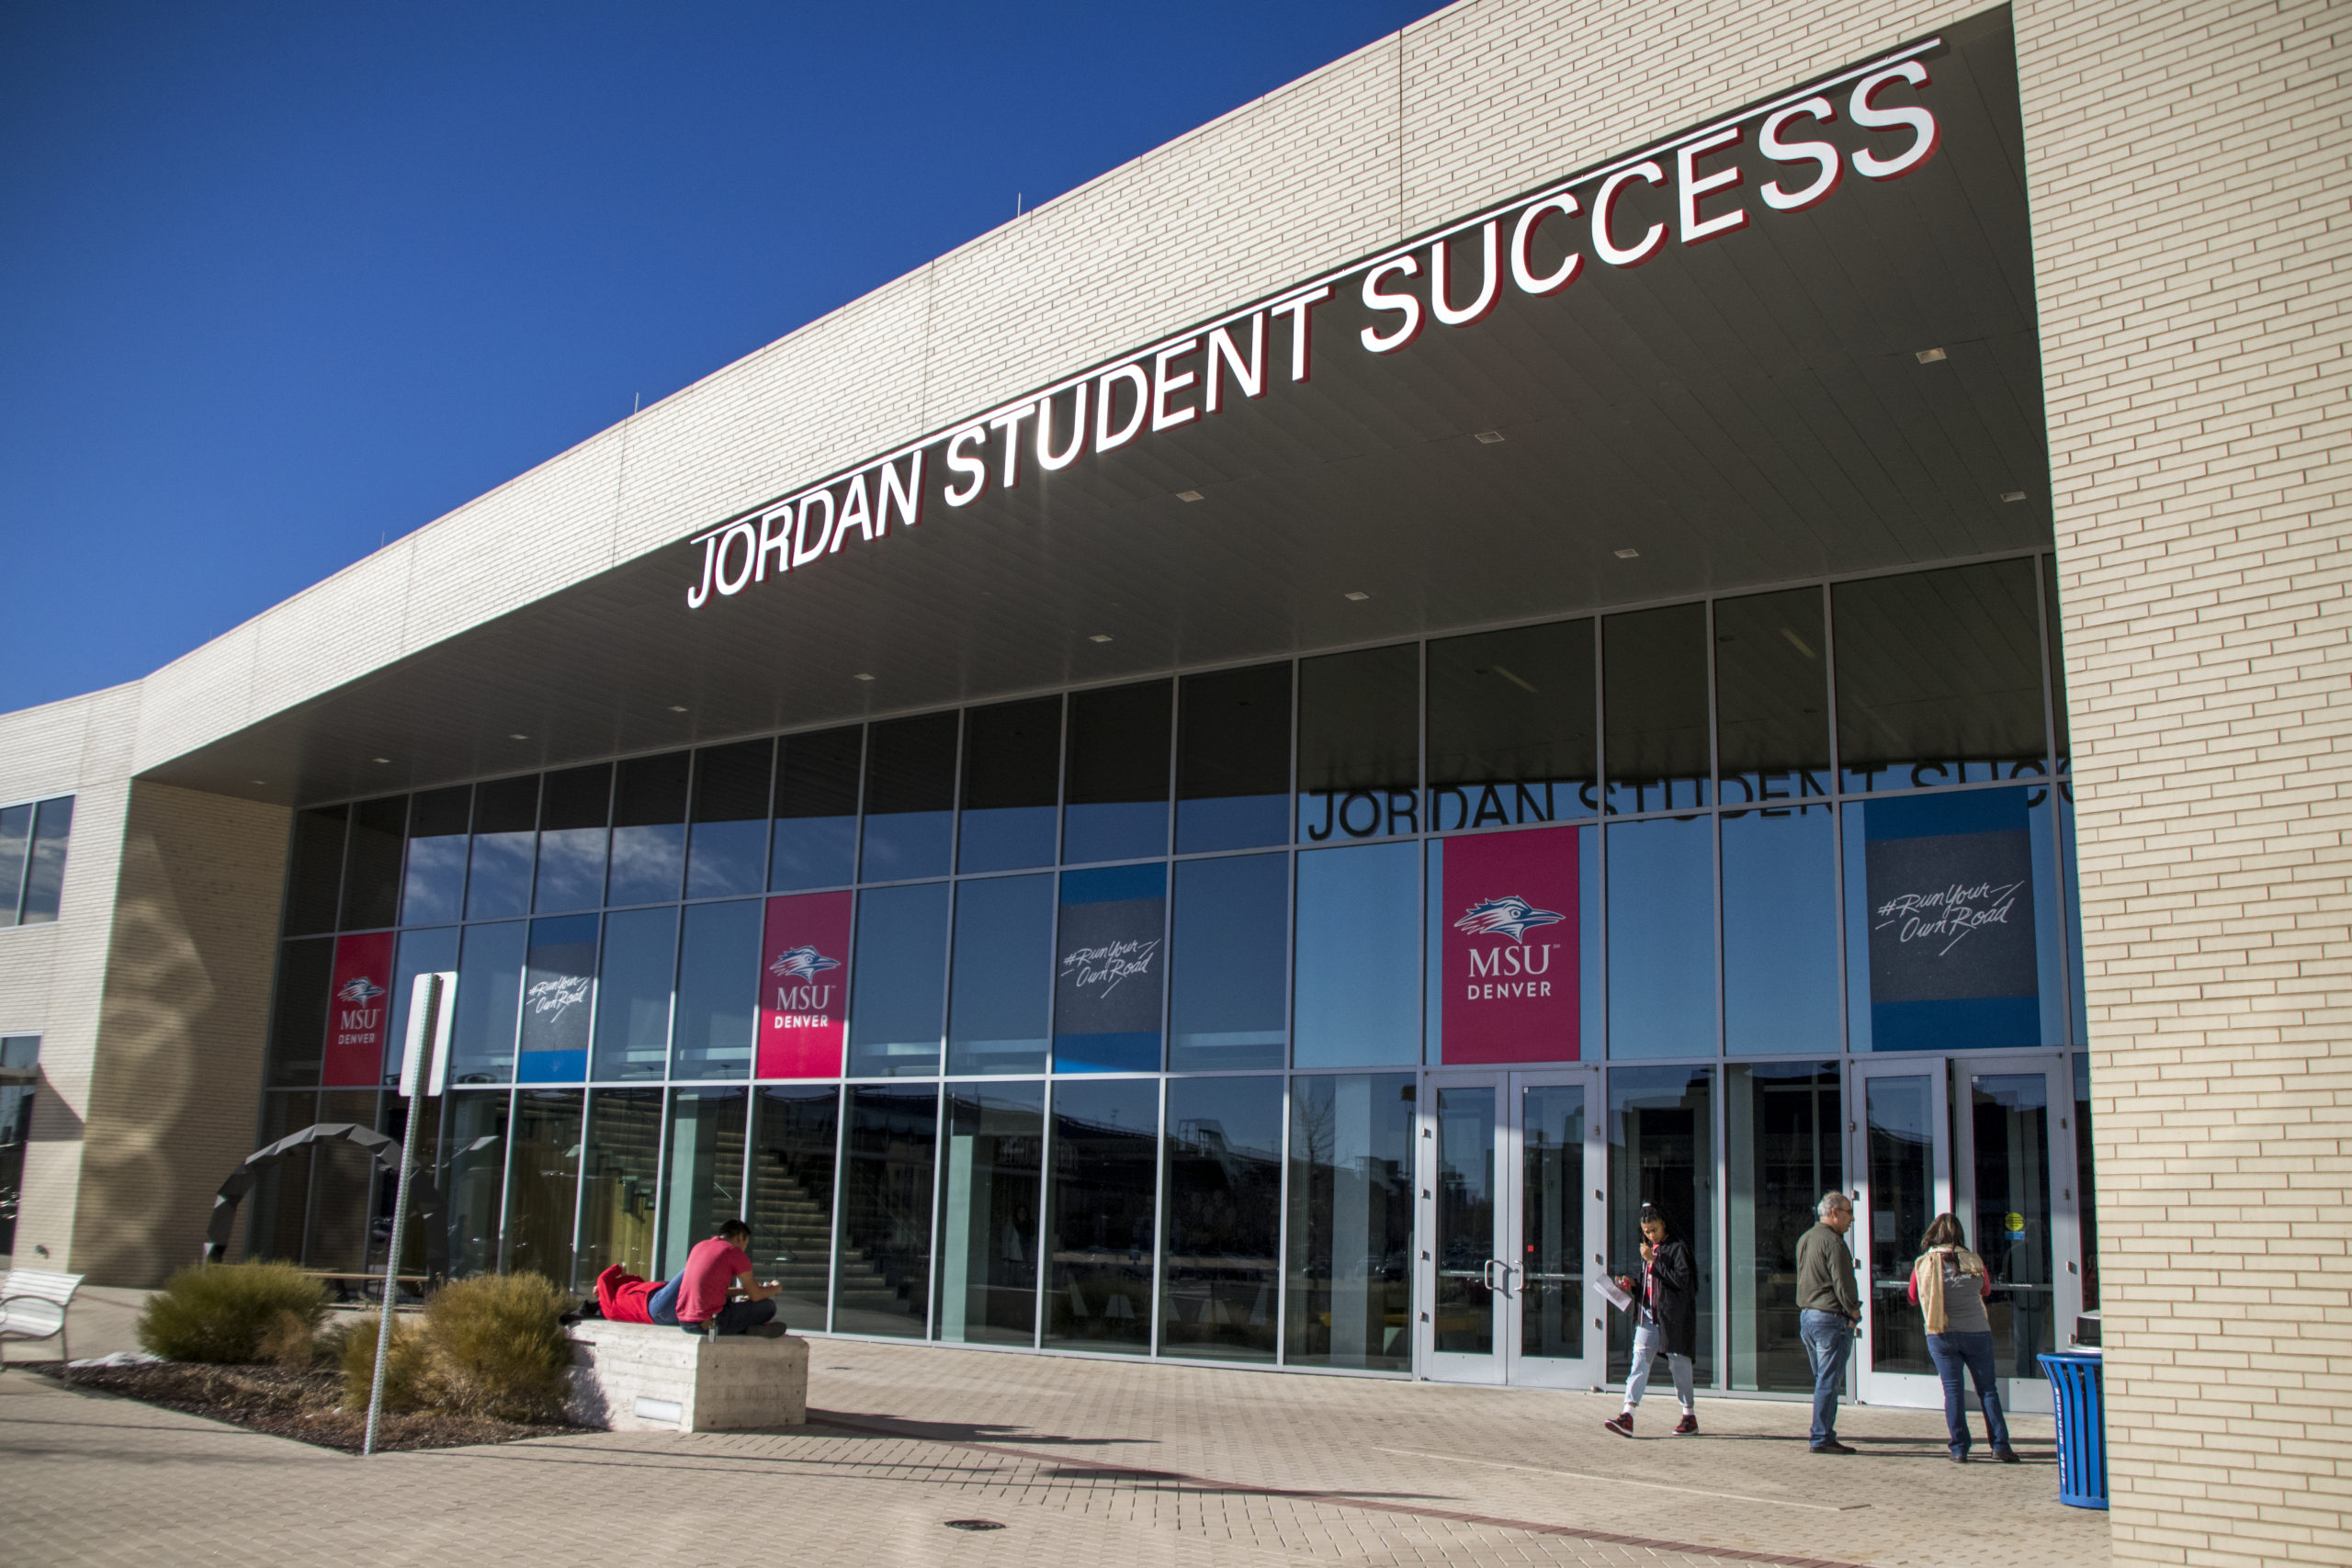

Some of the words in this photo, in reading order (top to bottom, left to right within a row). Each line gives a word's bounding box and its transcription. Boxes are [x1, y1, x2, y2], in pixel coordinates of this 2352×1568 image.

[686, 449, 925, 608] JORDAN
[944, 285, 1333, 507] STUDENT
[1360, 60, 1940, 355] SUCCESS
[1307, 783, 1555, 841] JORDAN
[1899, 917, 1947, 942] Own
[1949, 897, 2016, 936] Road
[1076, 966, 1107, 987] Own
[1108, 952, 1154, 983] Road
[1468, 943, 1551, 977] MSU
[775, 985, 831, 1010] MSU
[1467, 981, 1551, 1000] DENVER
[340, 1009, 378, 1030] MSU
[774, 1014, 829, 1029] DENVER
[337, 1032, 376, 1045] DENVER
